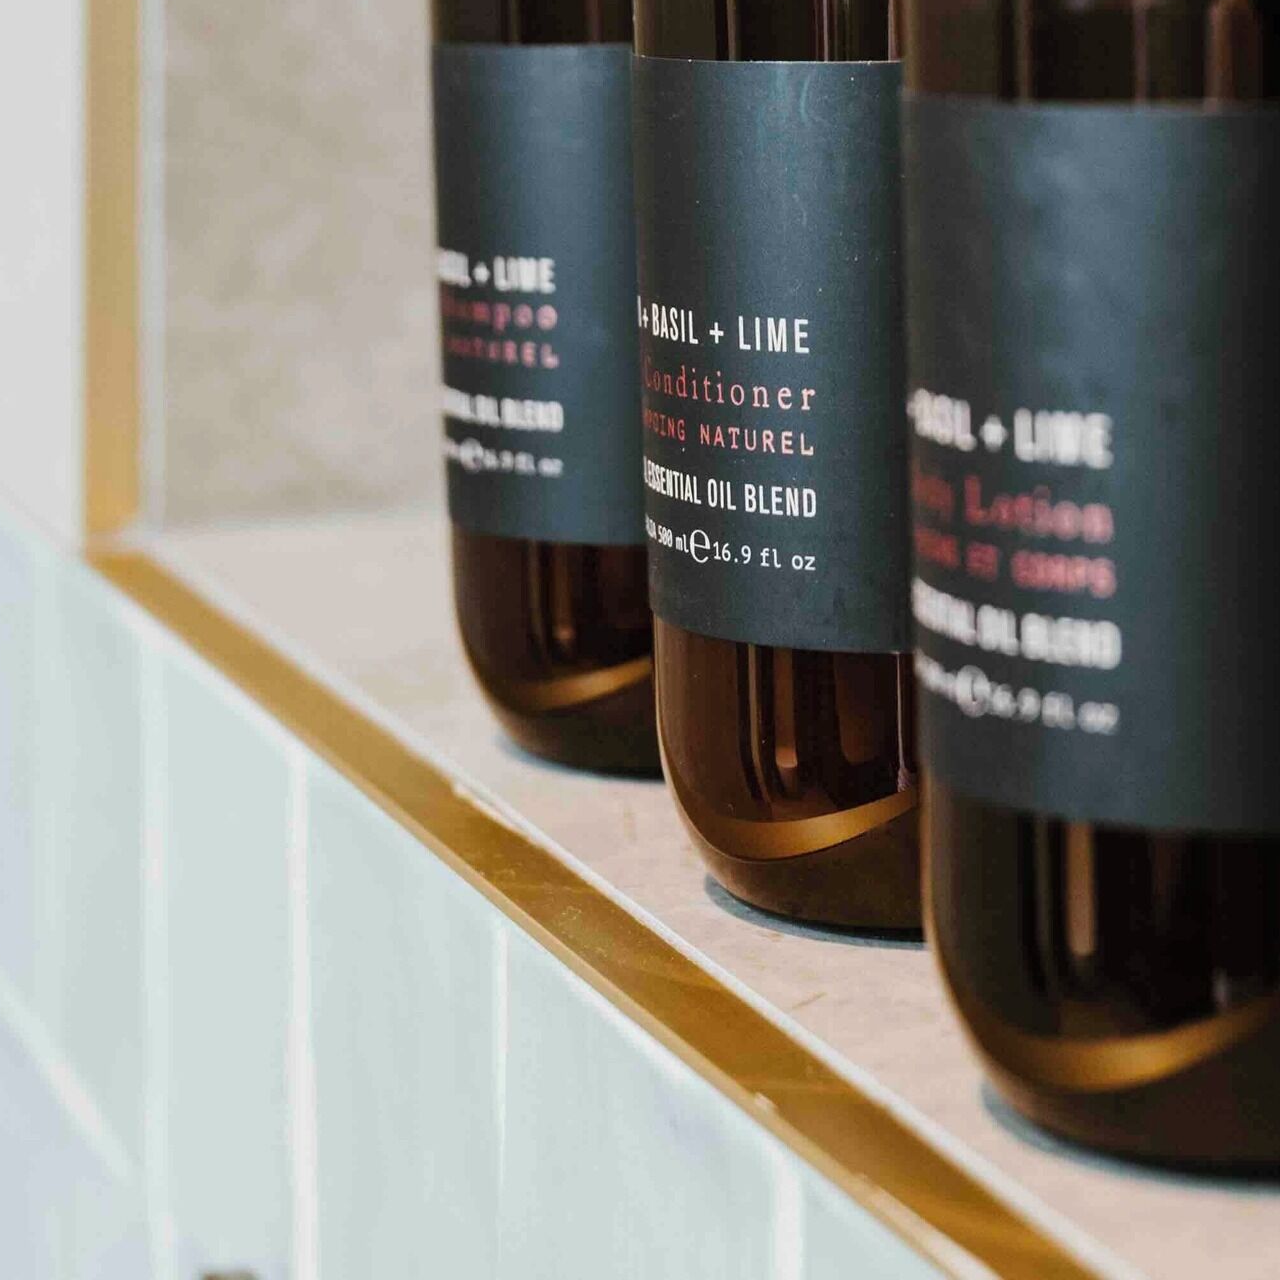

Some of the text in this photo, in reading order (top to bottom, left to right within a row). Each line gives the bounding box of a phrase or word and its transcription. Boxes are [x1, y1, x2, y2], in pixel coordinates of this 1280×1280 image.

[651, 302, 699, 345] BASIL
[709, 322, 724, 344] +
[738, 315, 810, 354] LIME
[643, 354, 816, 411] Conditioner
[700, 423, 814, 456] NATUREL
[1013, 407, 1114, 470] LIME
[707, 478, 736, 511] OIL
[744, 483, 817, 518] BLEND
[760, 547, 781, 569] fl
[791, 554, 816, 571] oz
